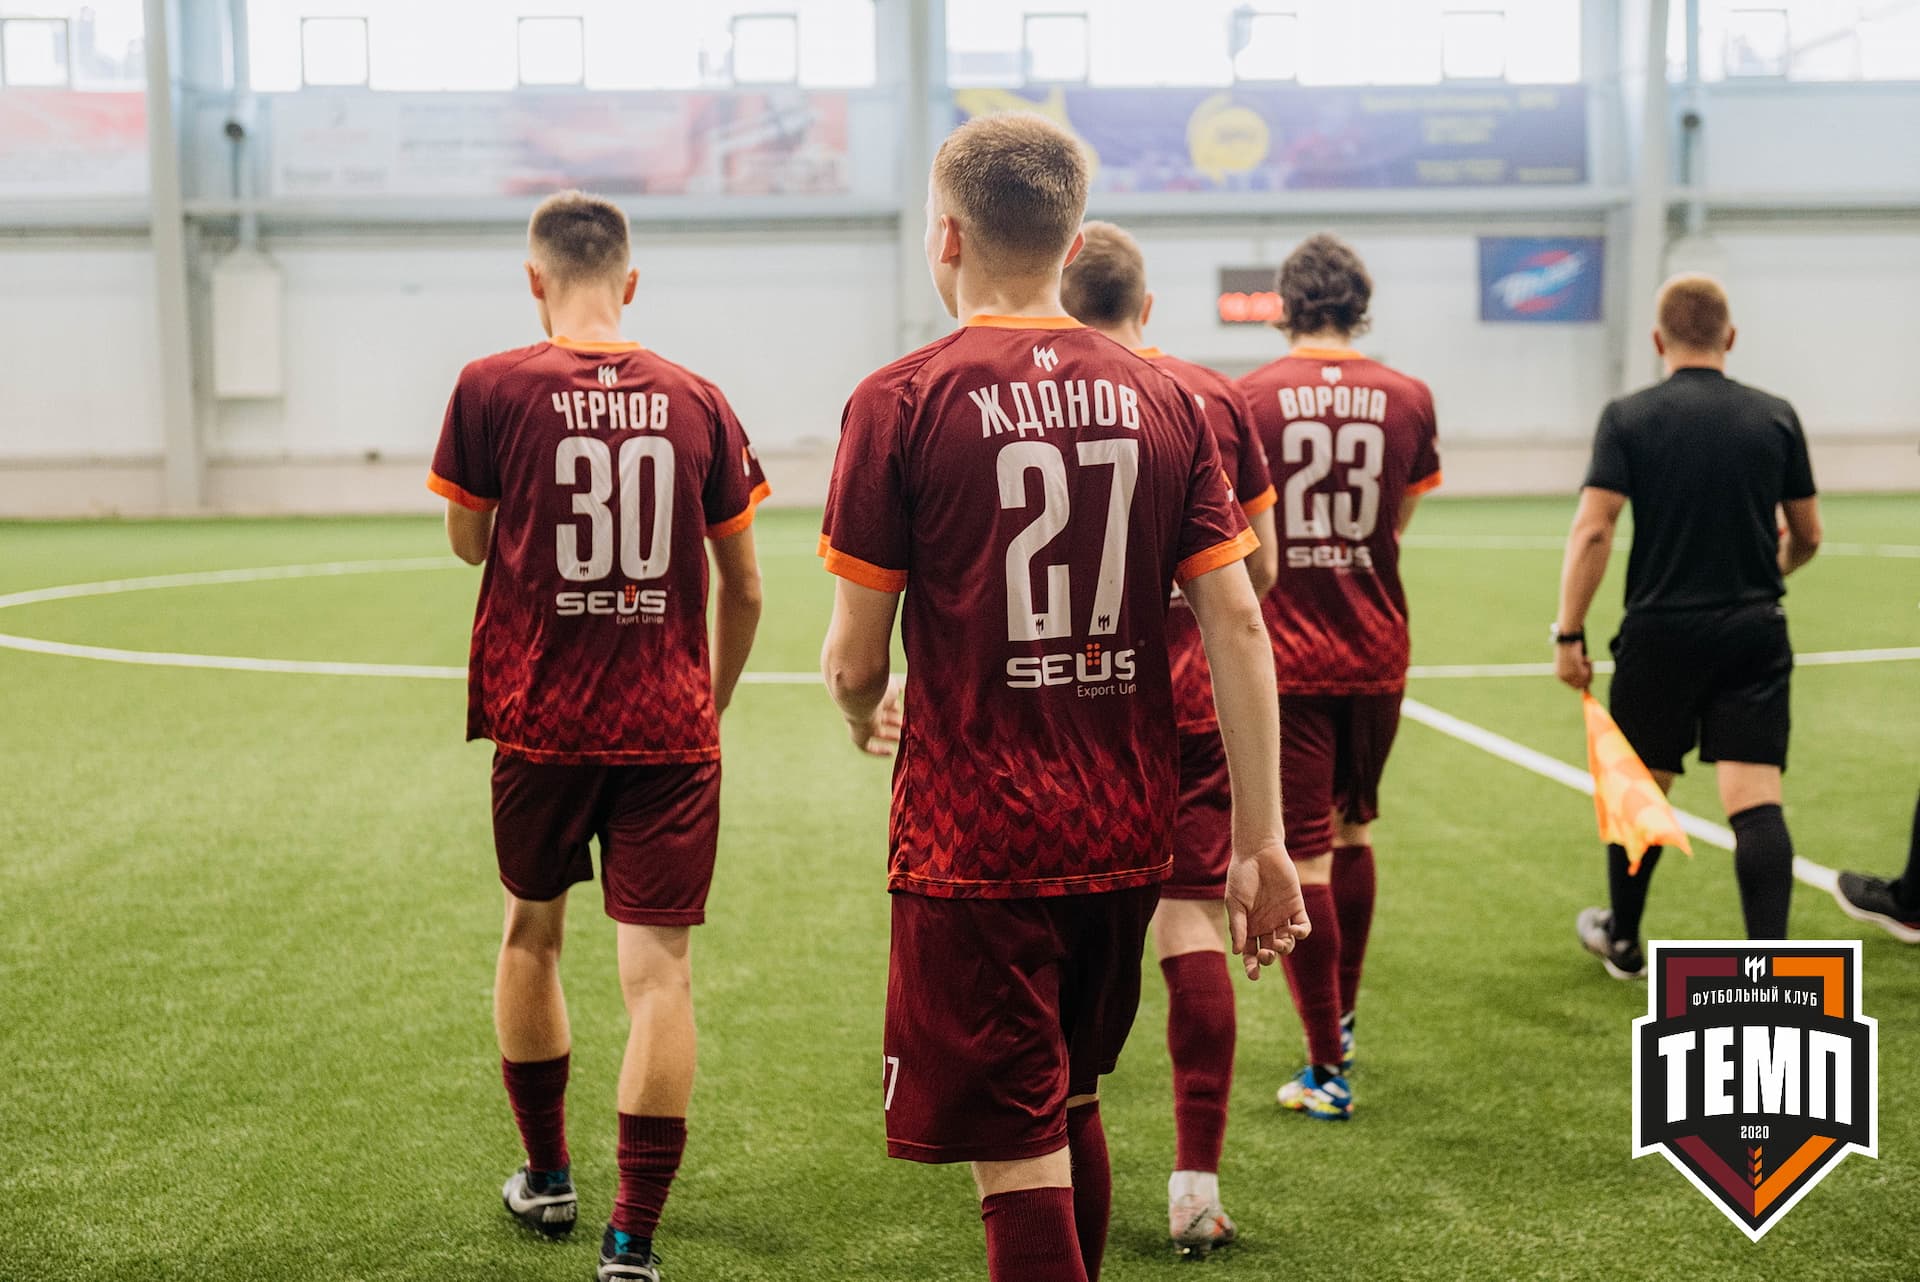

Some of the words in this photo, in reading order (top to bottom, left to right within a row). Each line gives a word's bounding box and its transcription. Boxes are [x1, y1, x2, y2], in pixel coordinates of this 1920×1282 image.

[552, 391, 670, 431] ЧЕРНОВ
[968, 378, 1141, 439] ЖДАНОВ
[1278, 385, 1387, 422] ВОРОНА
[555, 435, 675, 582] 30
[1282, 421, 1385, 541] 23
[996, 438, 1139, 642] 27
[1077, 684, 1116, 699] Export
